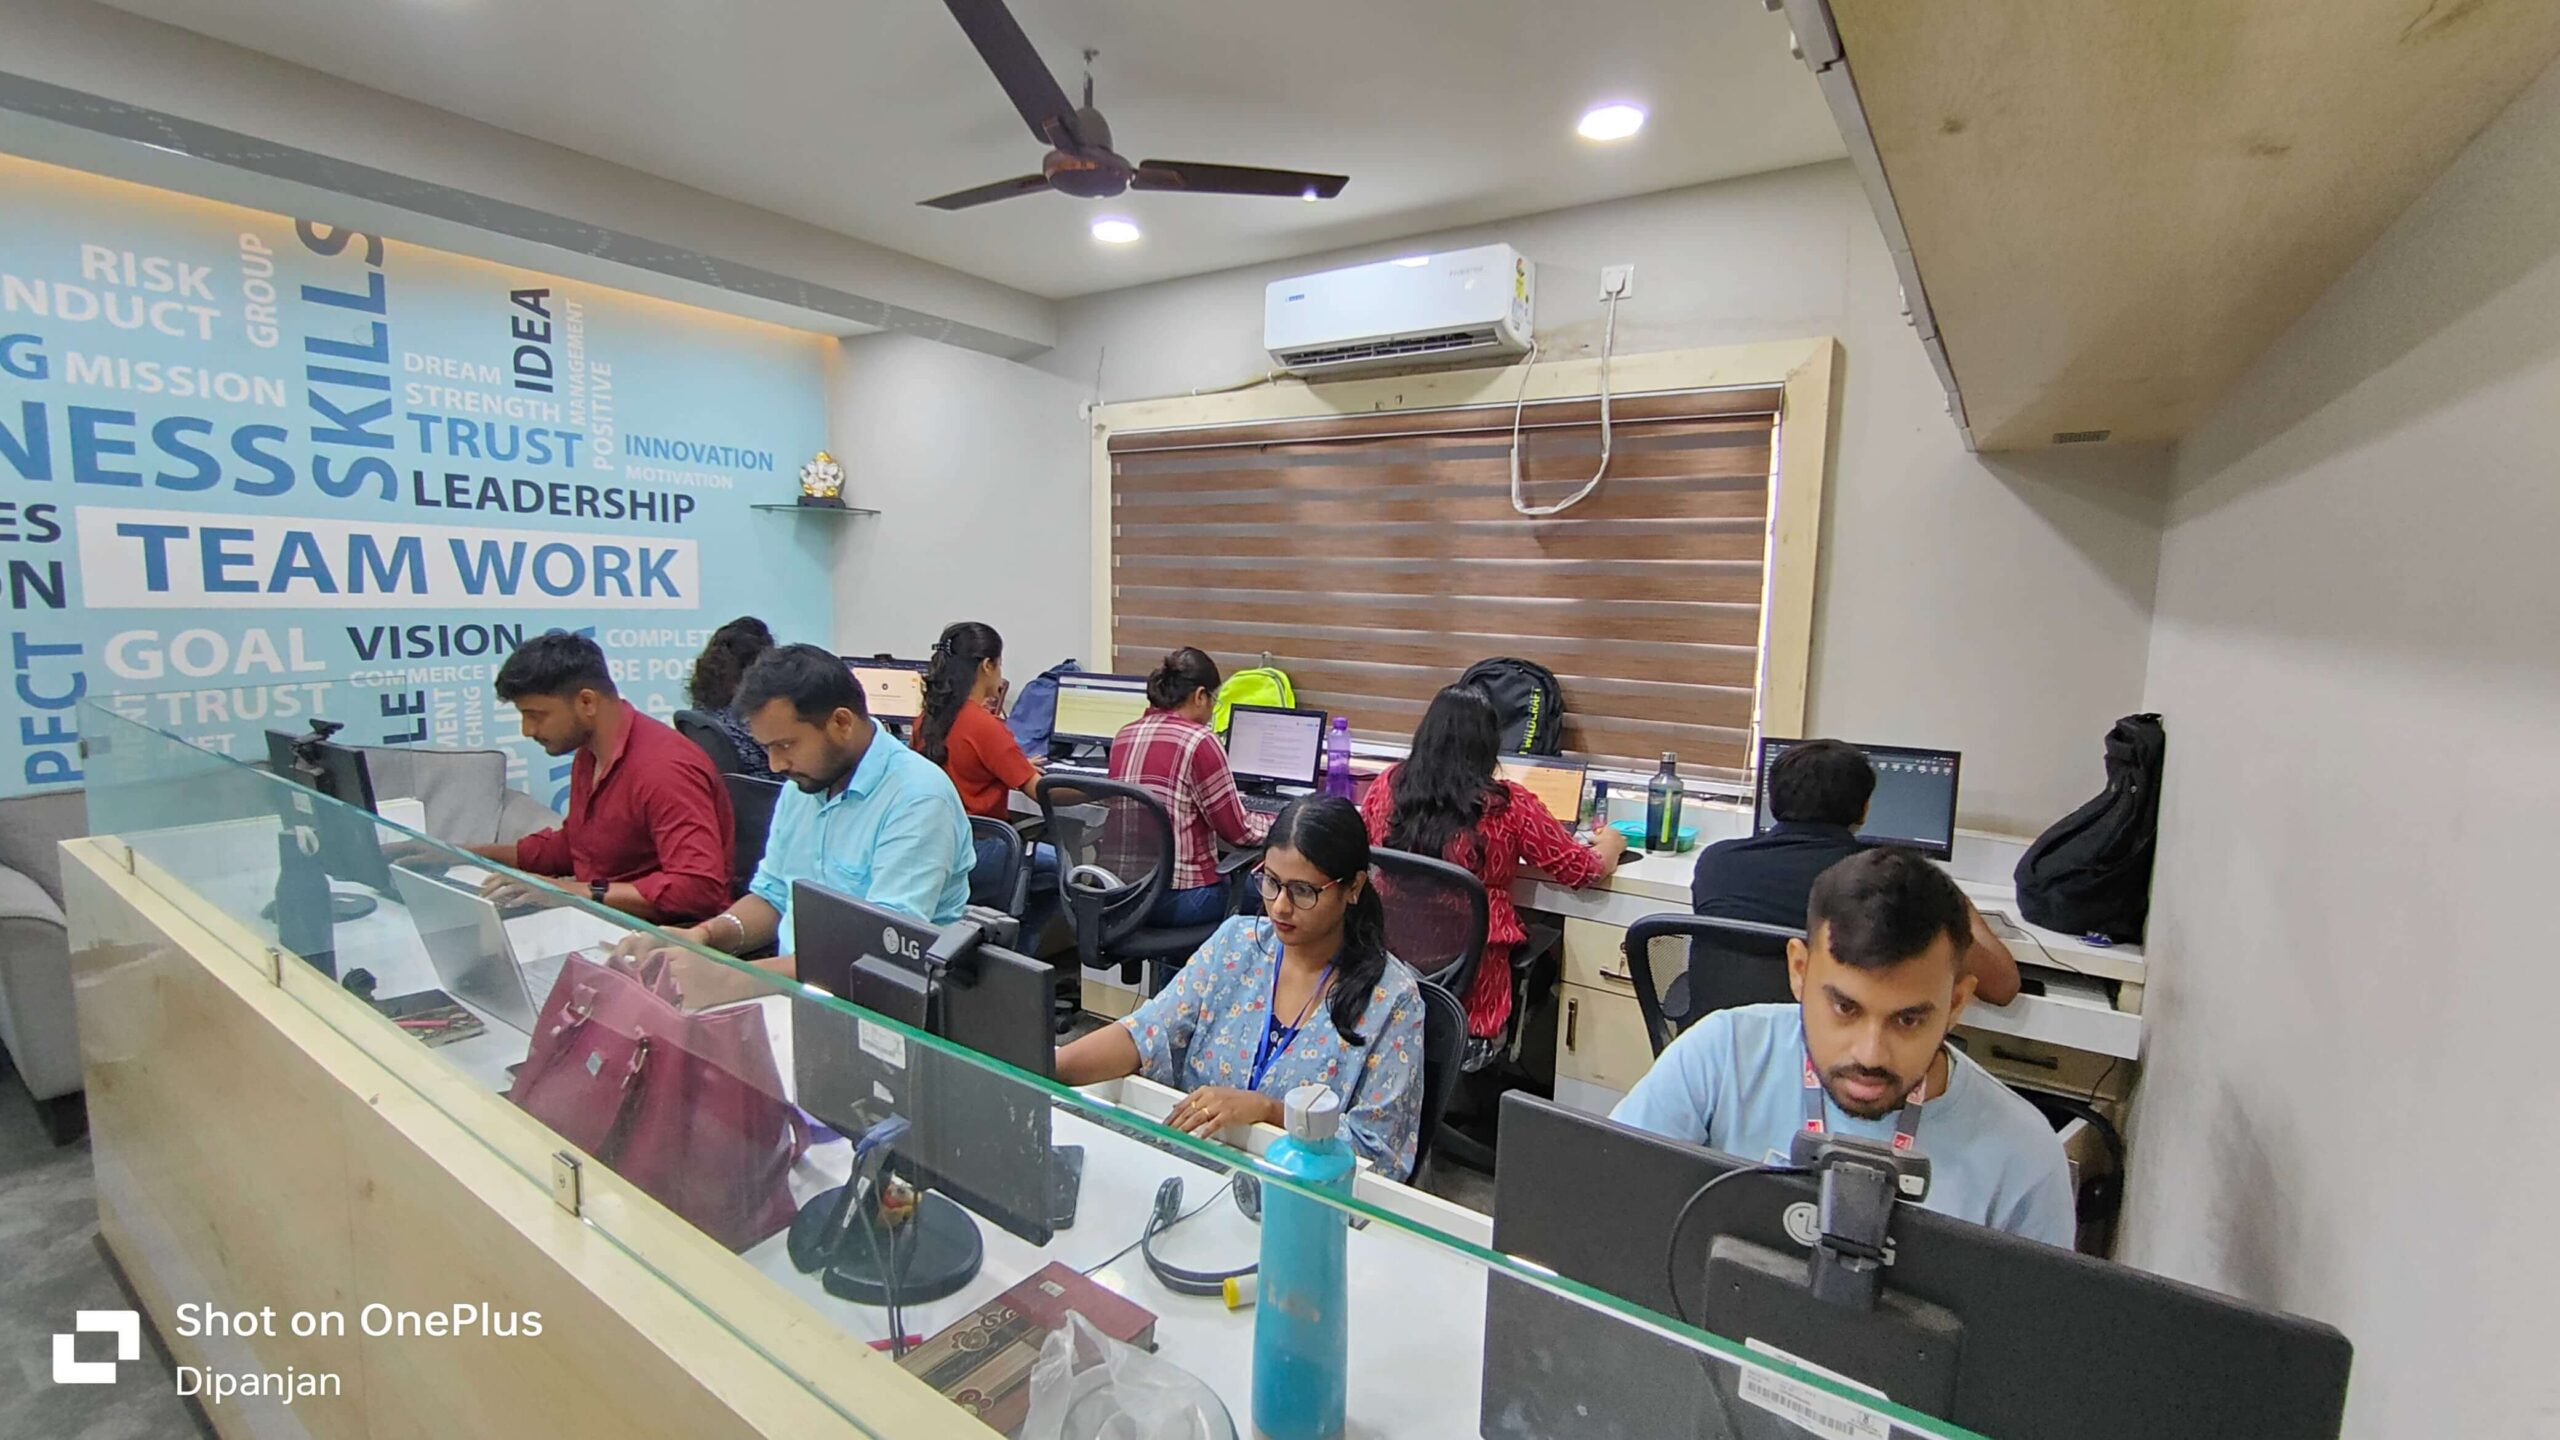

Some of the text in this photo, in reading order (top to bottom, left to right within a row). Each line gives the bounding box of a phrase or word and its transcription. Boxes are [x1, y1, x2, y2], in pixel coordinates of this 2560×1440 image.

[81, 244, 215, 300] RISK
[239, 233, 279, 348] GROUP
[1, 274, 221, 341] NDUCT
[294, 217, 398, 503] SKILLS
[511, 288, 554, 393] IDEA
[566, 298, 586, 426] MANAGEMENT
[66, 351, 285, 408] MISSION
[404, 352, 501, 385] DREAM
[405, 383, 561, 423] STRENGTH
[591, 361, 615, 471] POSITIVE
[406, 412, 583, 468] TRUST
[625, 434, 773, 471] INNOVATION
[413, 470, 696, 525] LEADERSHIP
[625, 464, 733, 489] MOTIVATION
[116, 523, 682, 598] TEAM WORK
[104, 627, 327, 680] GOAL
[346, 623, 523, 661] VISION
[350, 665, 485, 688] COMMERCE
[608, 659, 641, 682] BE
[156, 682, 333, 726] TRUST
[901, 936, 920, 960] LG
